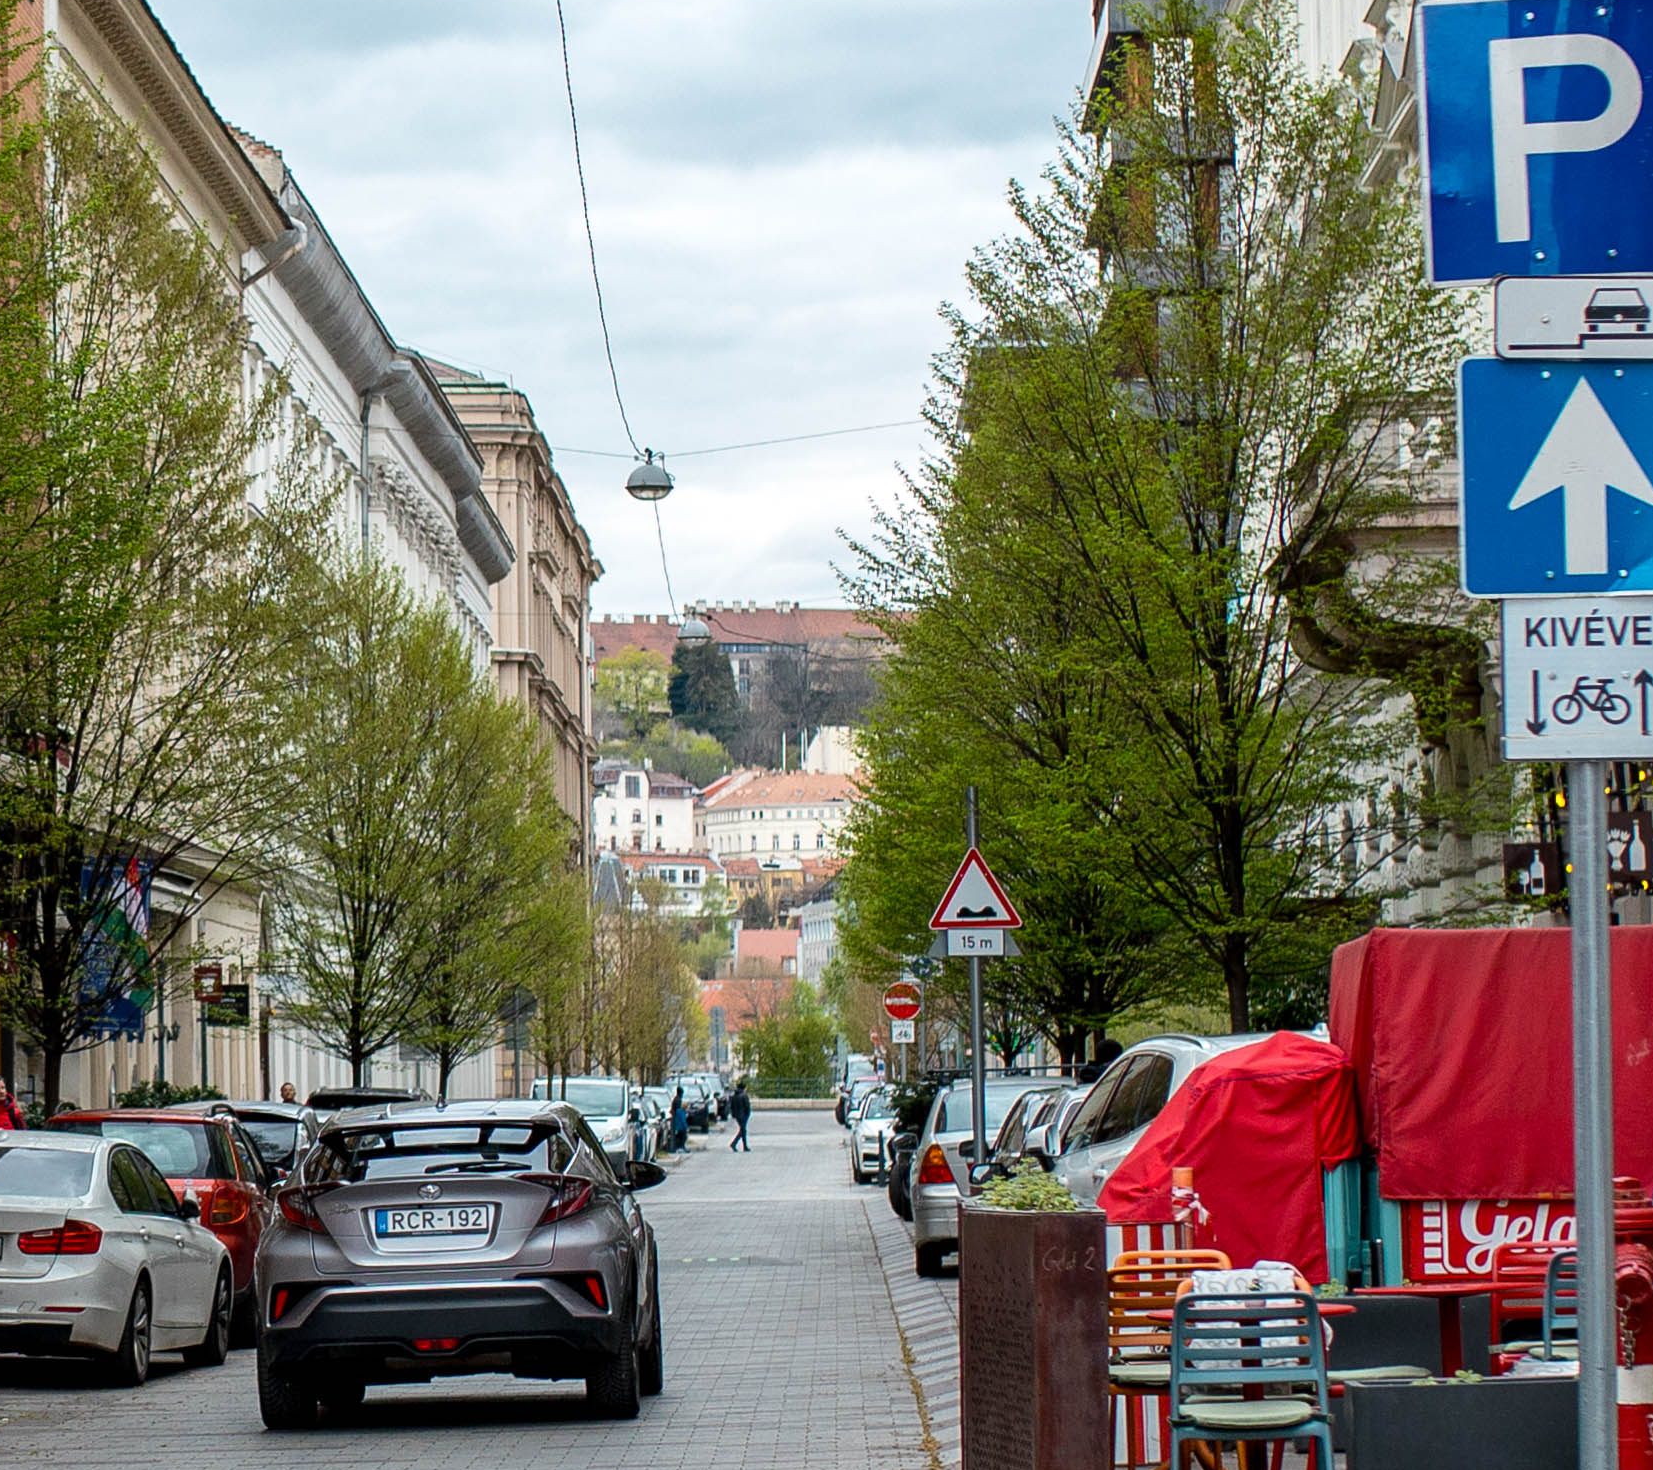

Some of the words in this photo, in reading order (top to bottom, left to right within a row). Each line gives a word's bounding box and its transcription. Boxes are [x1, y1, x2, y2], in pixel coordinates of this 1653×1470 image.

[1488, 33, 1644, 244] P
[1525, 608, 1653, 647] KIVÉVE
[961, 935, 975, 949] 15
[979, 940, 993, 949] m
[392, 1209, 483, 1230] RCR-192
[1460, 1199, 1579, 1275] Gela
